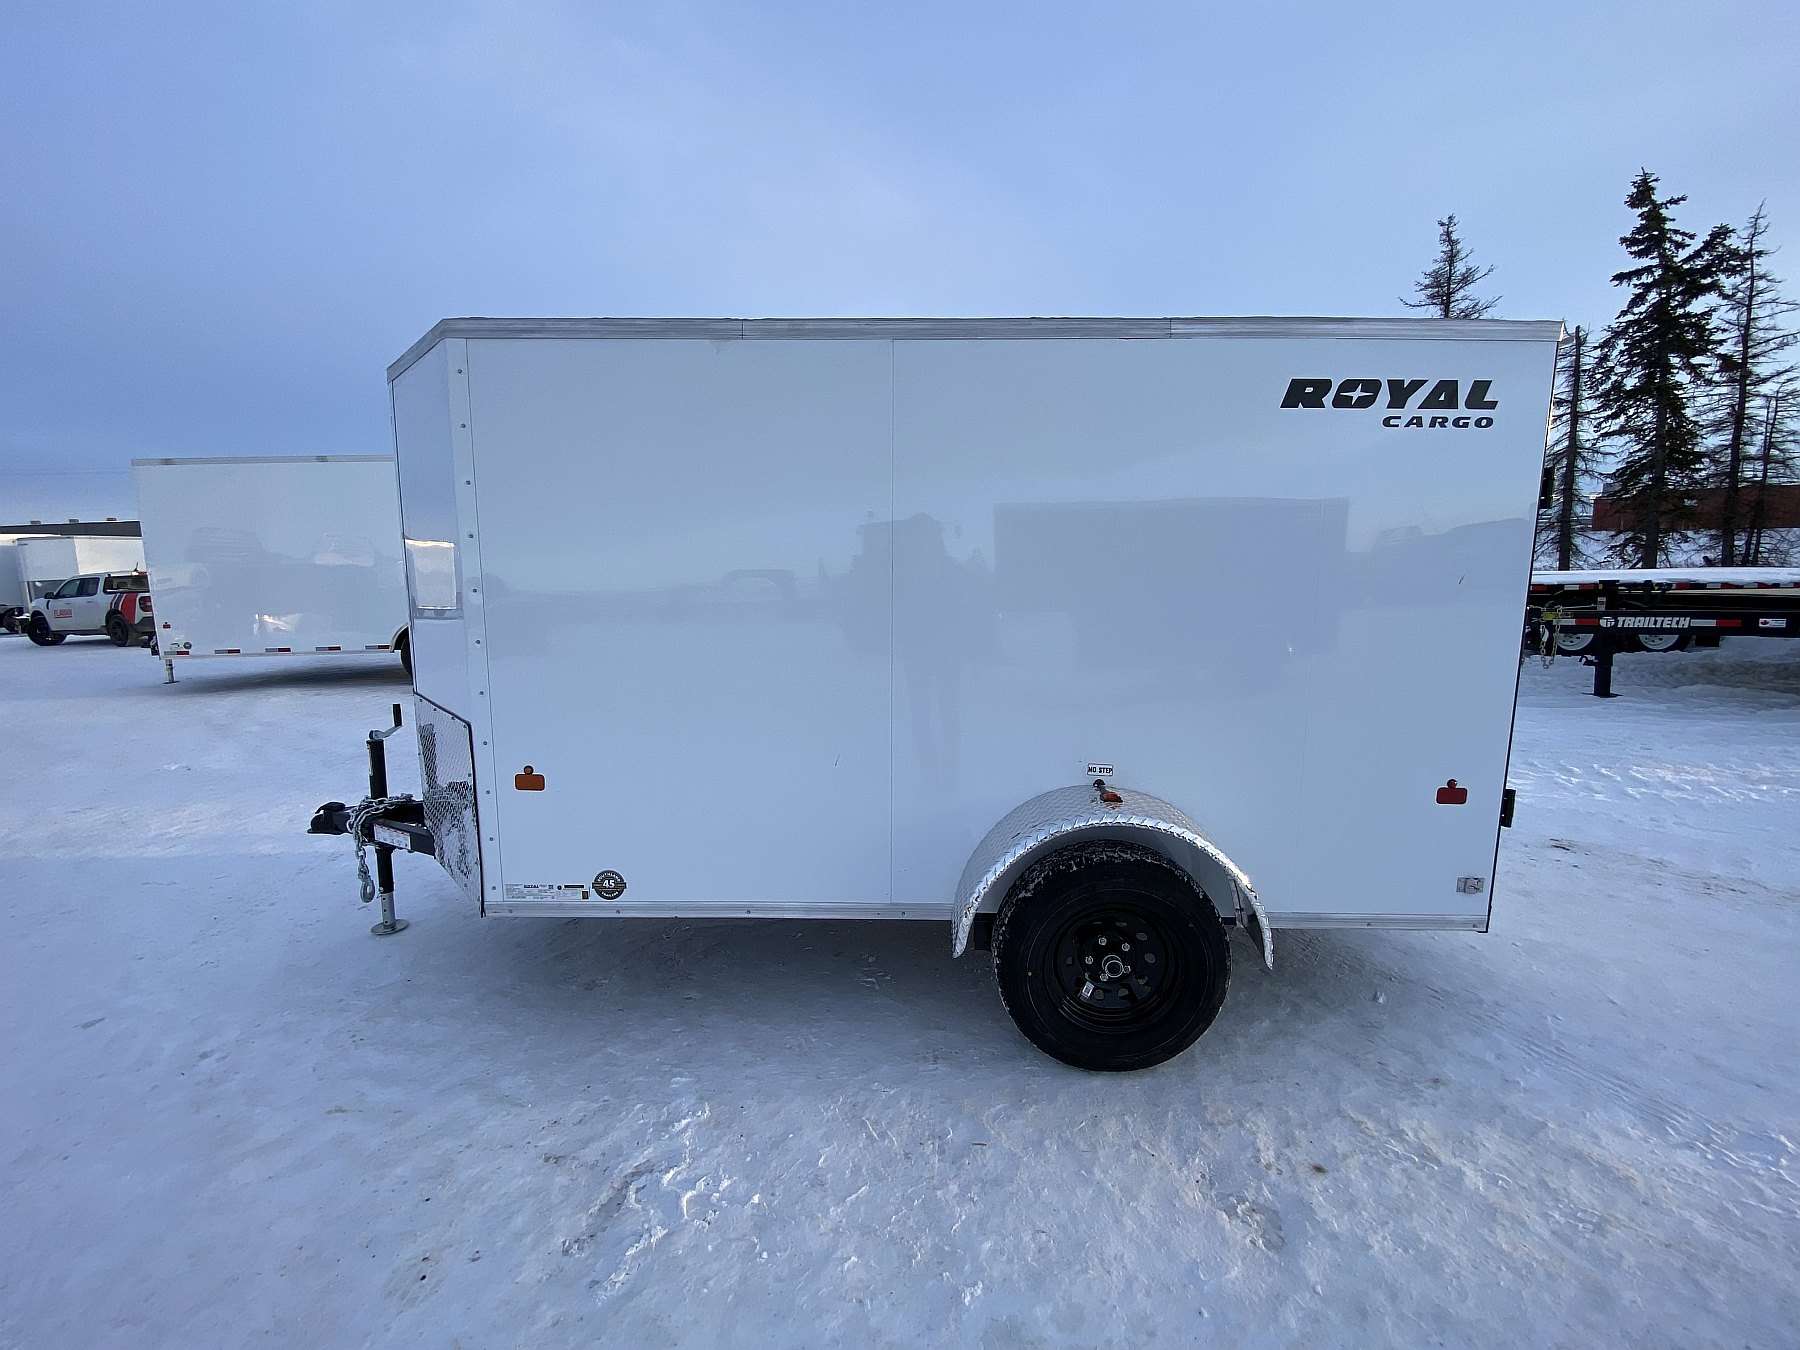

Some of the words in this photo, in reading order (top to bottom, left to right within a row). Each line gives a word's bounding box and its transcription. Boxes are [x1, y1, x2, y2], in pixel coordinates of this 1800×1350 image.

[1280, 379, 1498, 410] ROYAL
[1382, 416, 1494, 428] CARGO
[1617, 616, 1690, 628] TRAILTECH
[603, 880, 614, 888] 45
